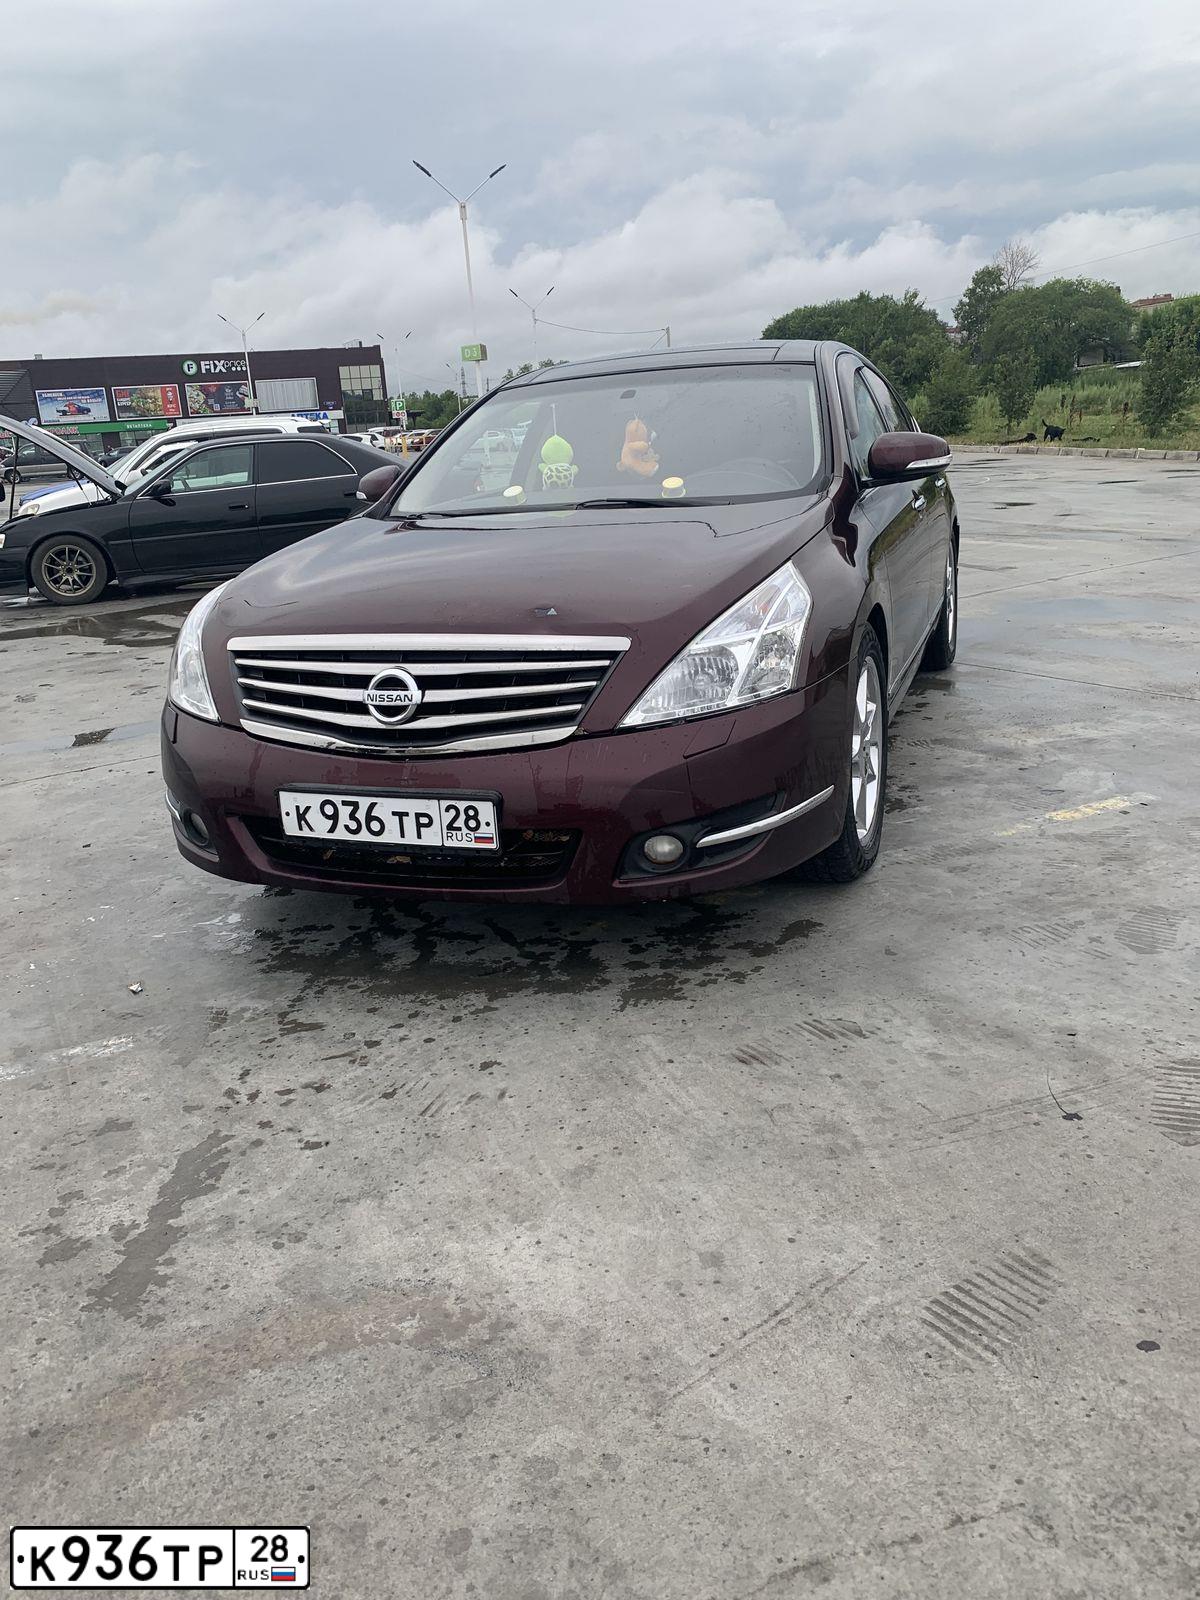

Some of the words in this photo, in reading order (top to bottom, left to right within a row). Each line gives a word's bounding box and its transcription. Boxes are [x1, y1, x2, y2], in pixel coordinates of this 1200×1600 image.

[200, 360, 227, 373] FIX
[224, 359, 246, 369] price
[396, 401, 403, 411] P
[366, 693, 413, 703] NISSAN
[445, 804, 481, 832] 28
[446, 831, 473, 843] RUS
